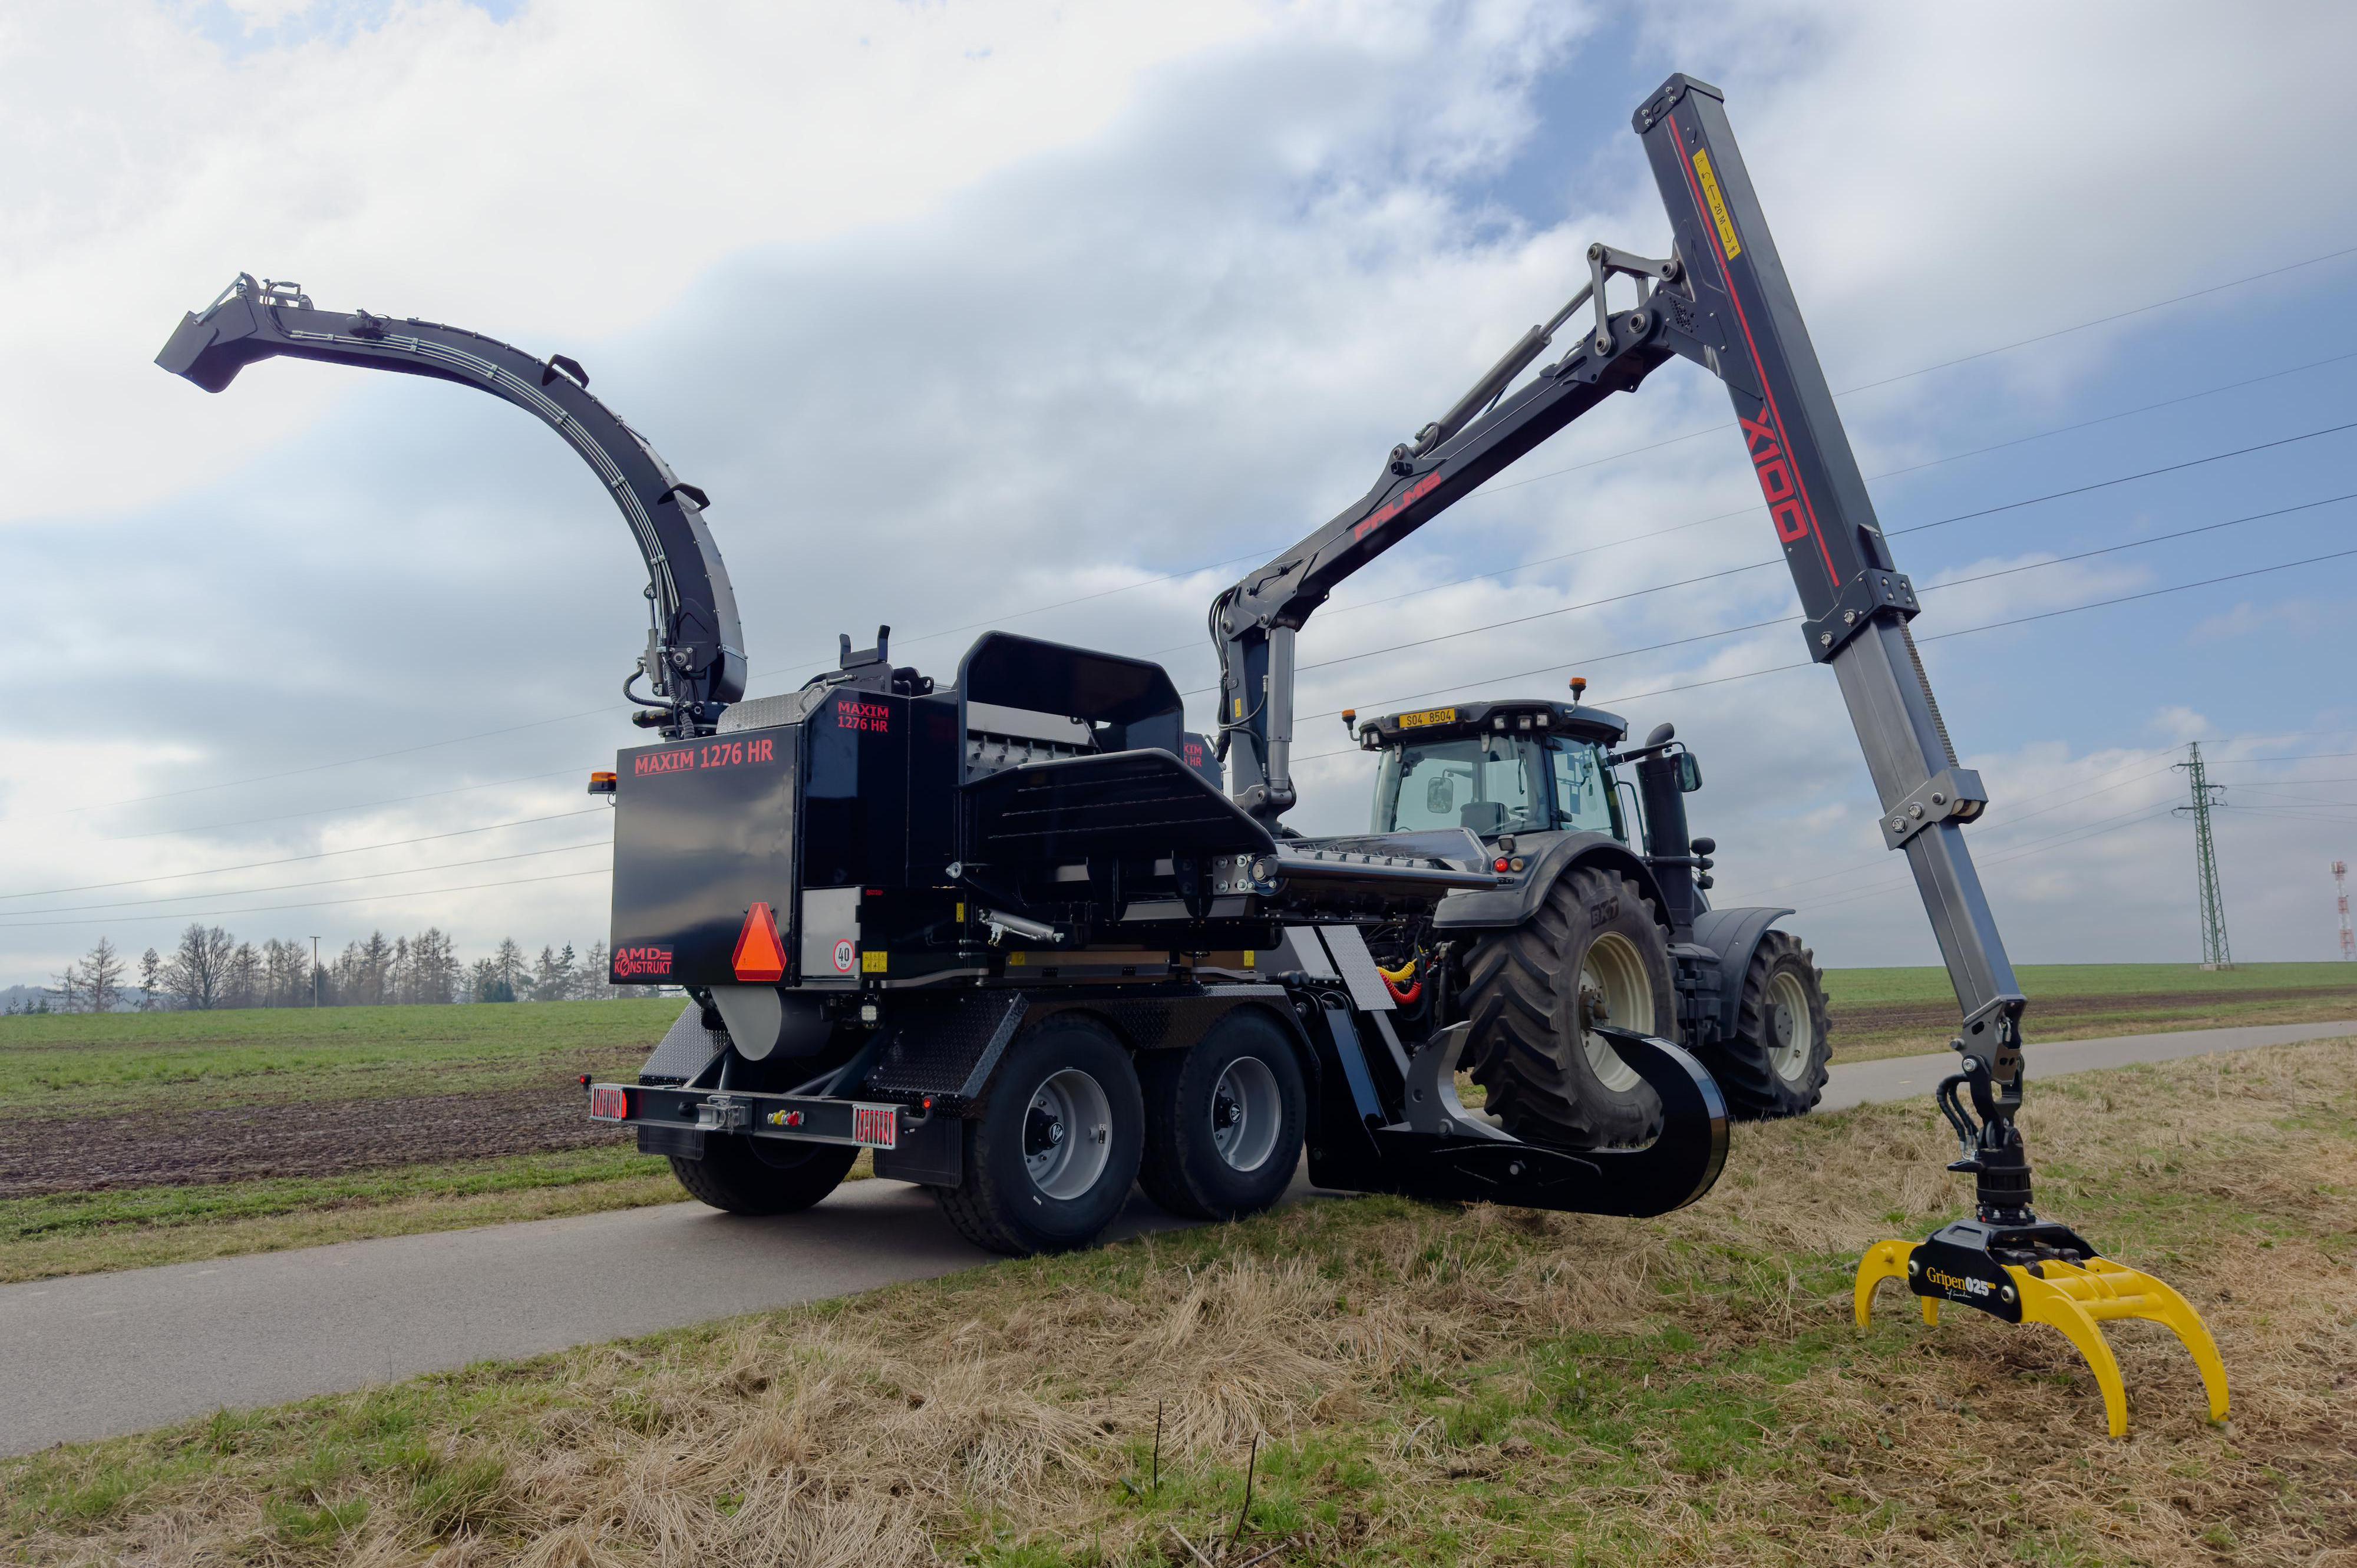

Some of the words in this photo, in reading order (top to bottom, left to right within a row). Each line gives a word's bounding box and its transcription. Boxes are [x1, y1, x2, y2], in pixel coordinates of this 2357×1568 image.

[1714, 203, 1722, 215] 20
[1719, 214, 1726, 225] M
[1738, 404, 1809, 543] X100
[1354, 470, 1442, 543] PALMS
[838, 701, 889, 718] MAXIM
[1429, 709, 1451, 723] 8504
[838, 715, 868, 730] 1276
[871, 719, 889, 732] HR
[635, 750, 694, 775] MAXIM
[700, 741, 742, 768] 1276
[747, 738, 774, 763] HR
[1190, 755, 1203, 767] HR
[1590, 896, 1619, 930] BKT
[615, 948, 661, 960] AMD
[838, 947, 850, 962] 40
